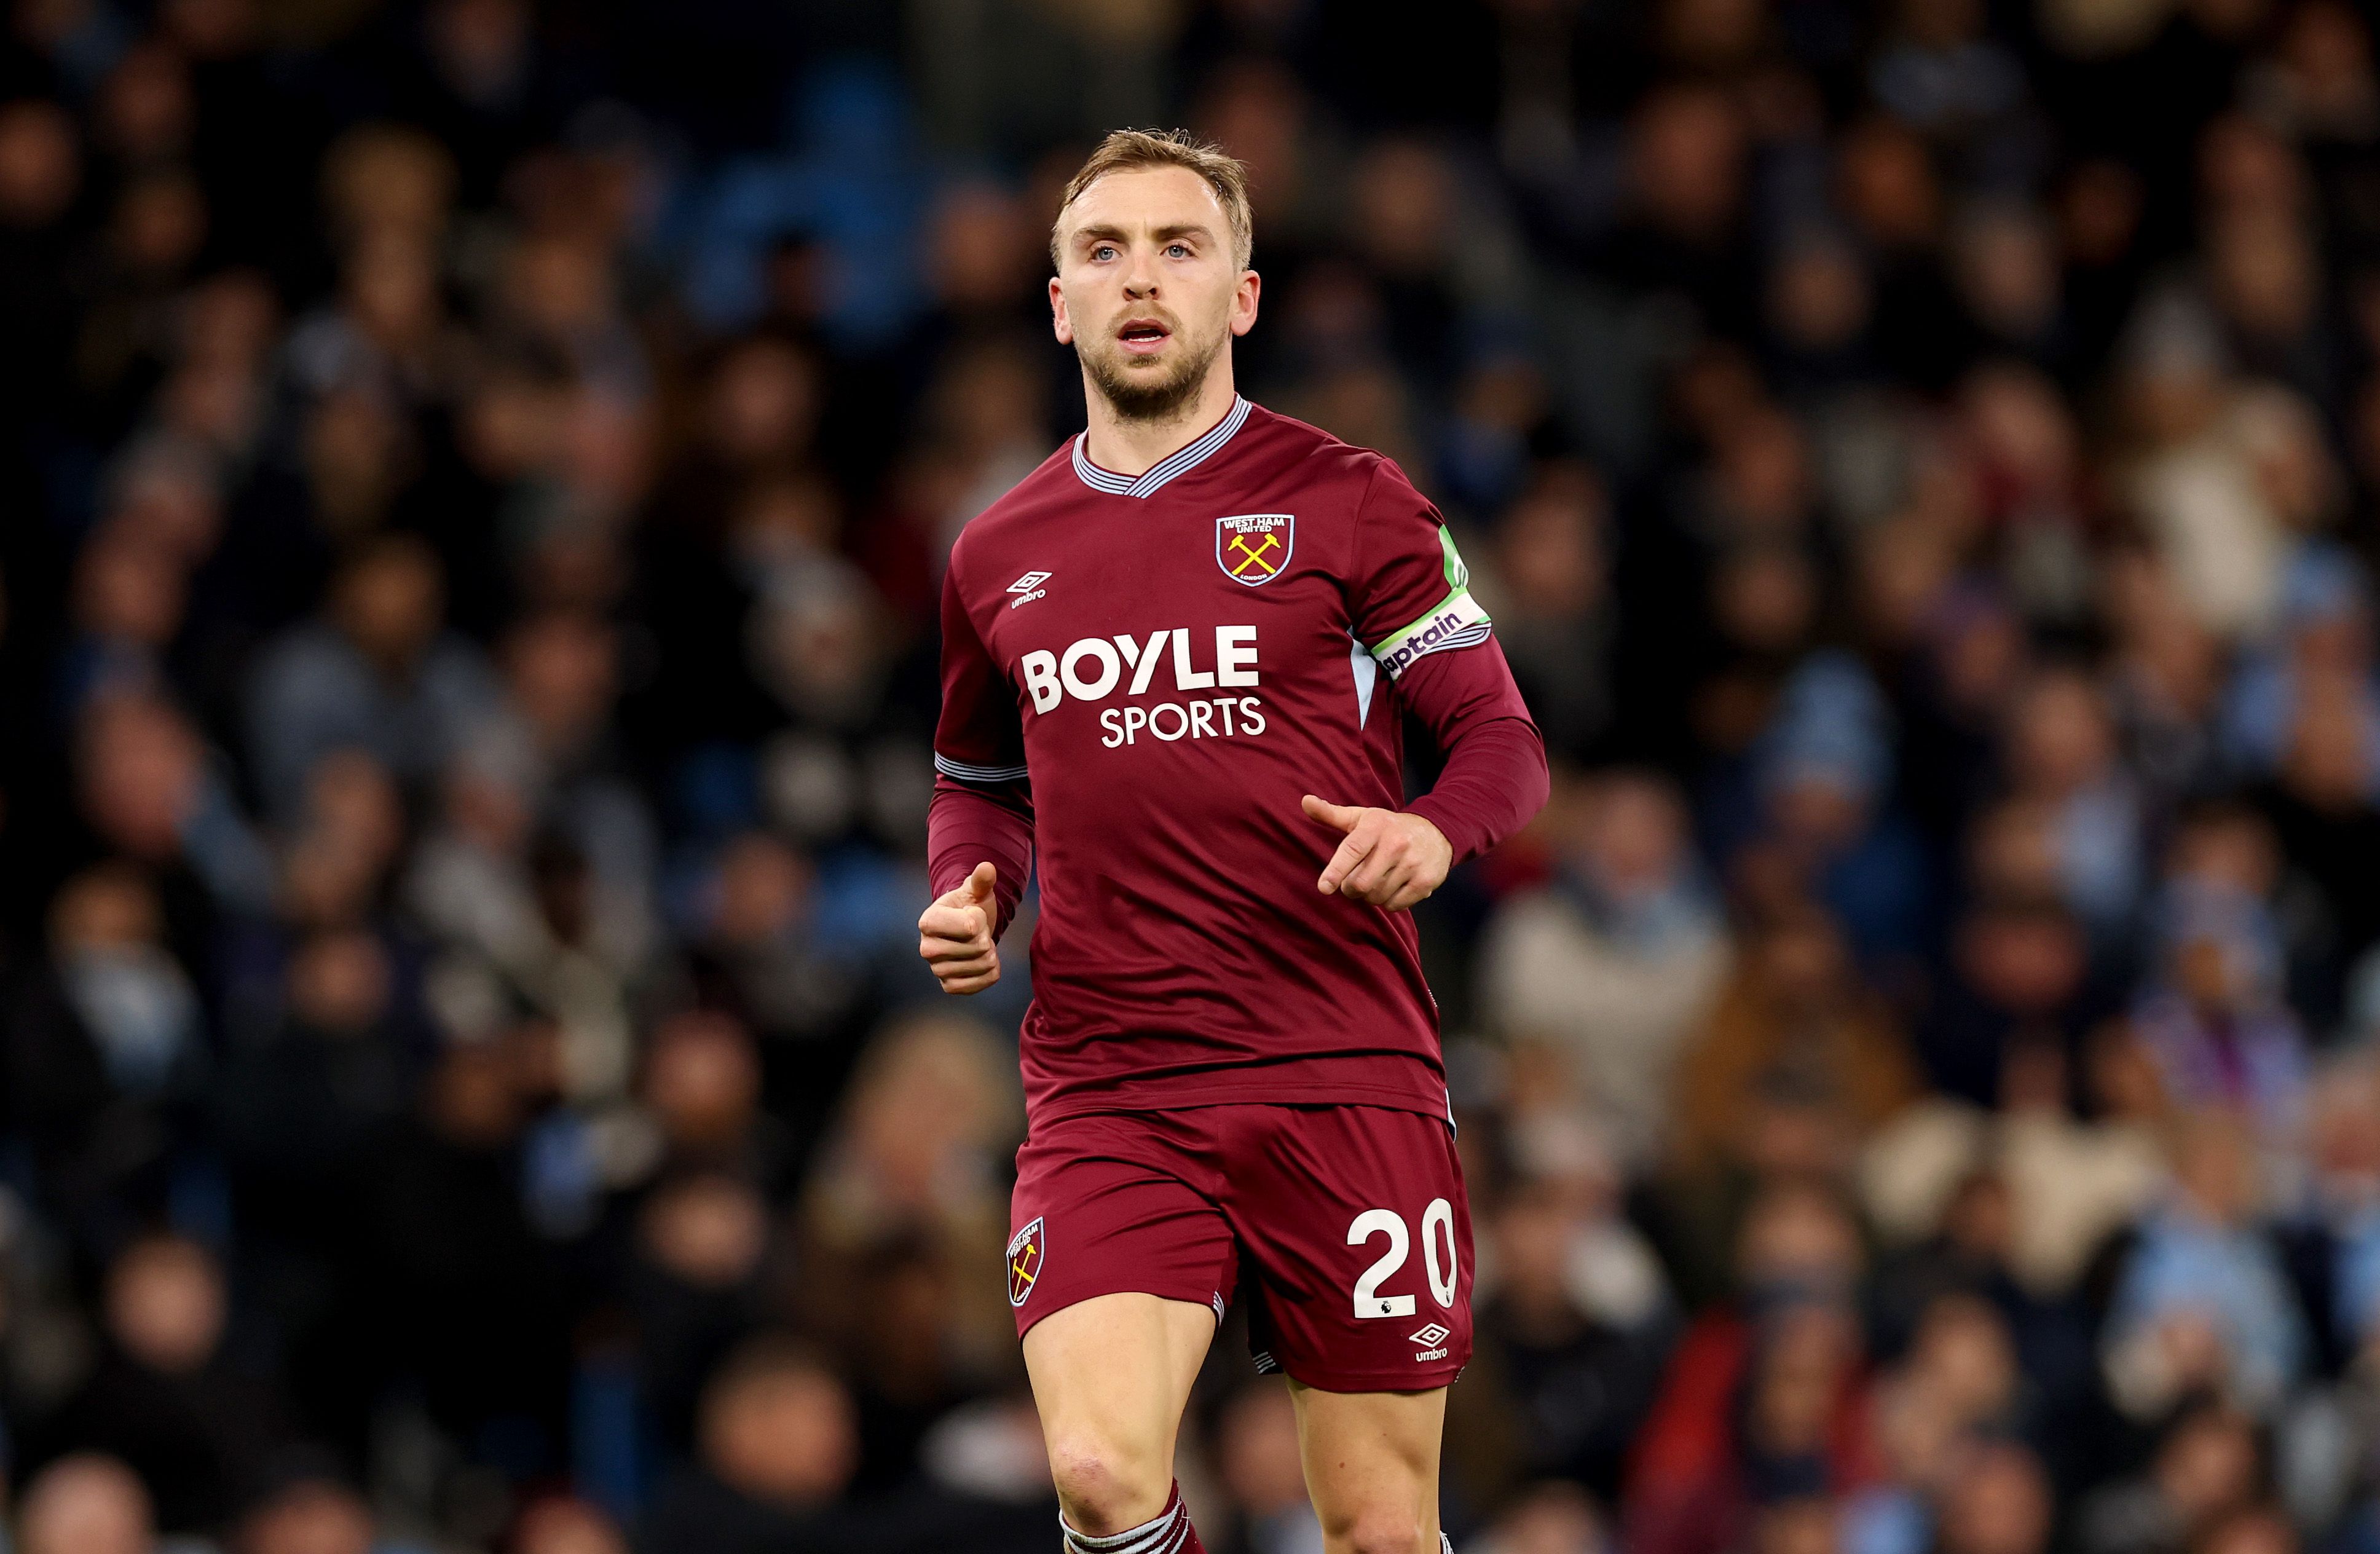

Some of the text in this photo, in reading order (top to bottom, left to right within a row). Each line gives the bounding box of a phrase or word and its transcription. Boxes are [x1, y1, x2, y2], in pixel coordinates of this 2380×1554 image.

[1224, 518, 1285, 529] WEST HAM
[1011, 589, 1046, 609] umbro
[1382, 613, 1463, 672] aptain
[1021, 625, 1259, 716] BOYLE
[1100, 697, 1266, 748] SPORTS
[1022, 1224, 1038, 1240] HAM
[1347, 1197, 1457, 1319] 20
[1416, 1347, 1448, 1362] umbro
